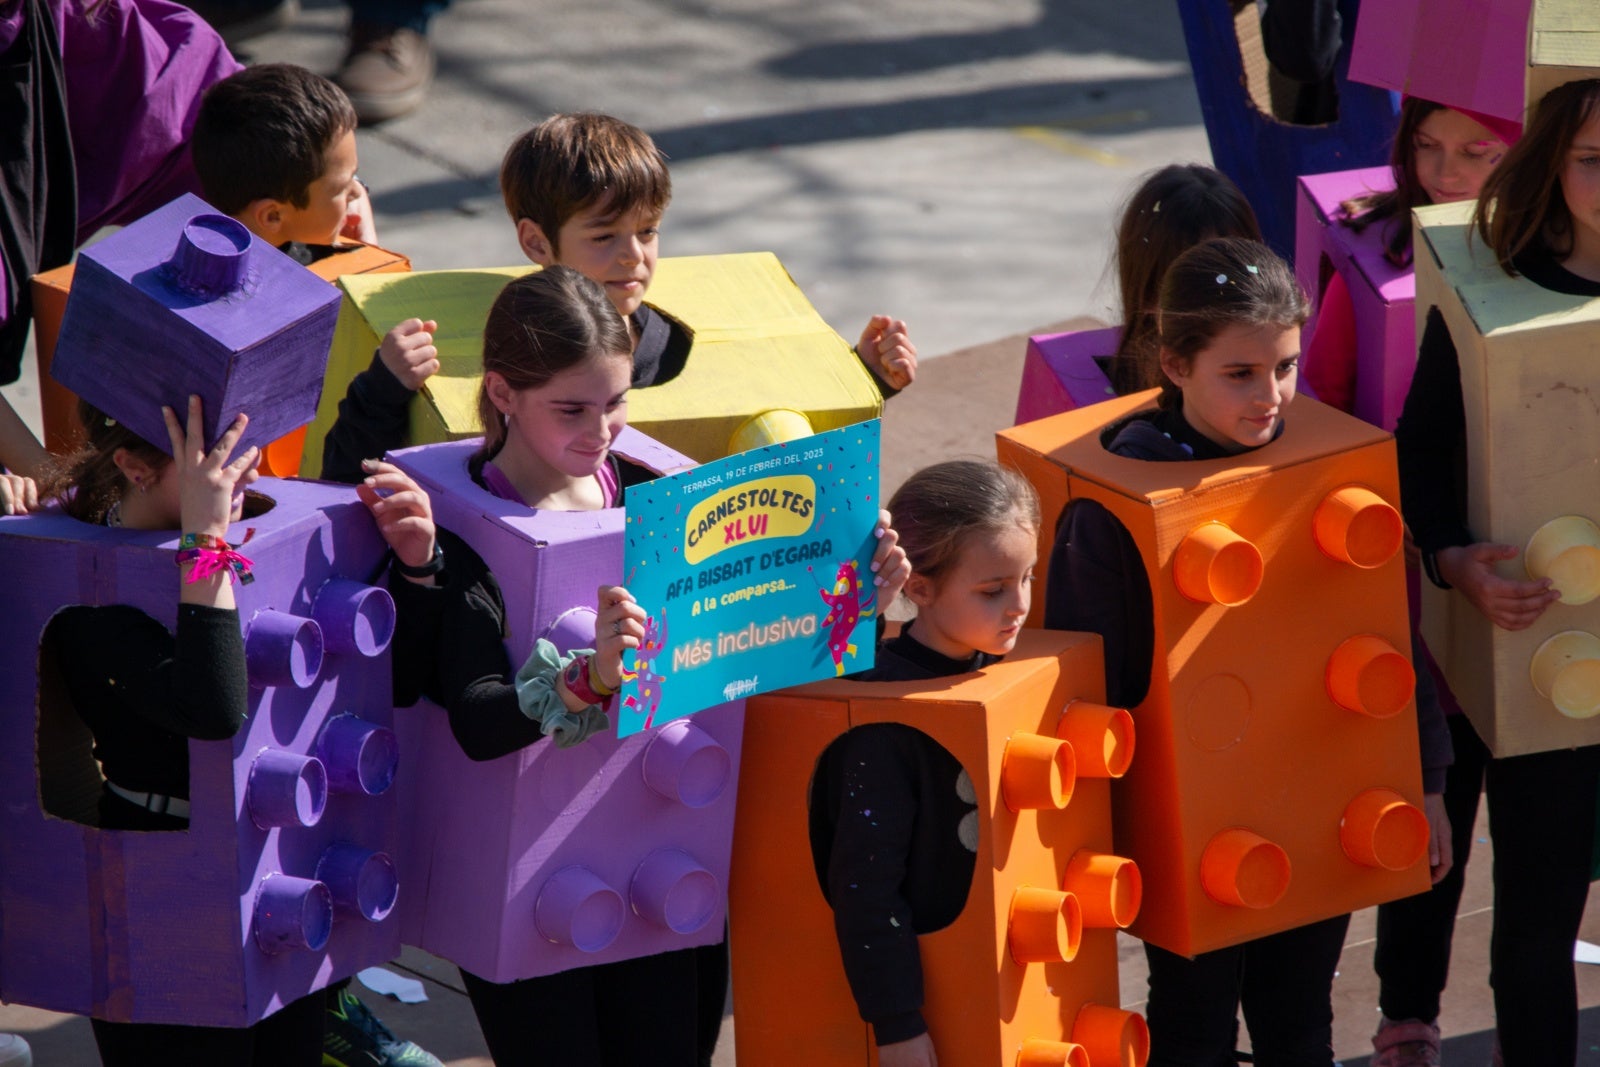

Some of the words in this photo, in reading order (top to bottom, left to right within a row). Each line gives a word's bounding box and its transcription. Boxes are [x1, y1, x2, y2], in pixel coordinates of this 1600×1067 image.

[683, 477, 723, 494] TERRASSA,
[726, 471, 734, 480] 19
[736, 466, 747, 478] DE
[749, 458, 782, 473] FEBRER
[784, 454, 801, 466] DEL
[803, 448, 824, 461] 2023
[688, 488, 813, 548] CARNESTOLTES
[666, 576, 693, 601] AFA
[698, 556, 755, 590] BISBAT
[760, 538, 833, 571] D'EGARA
[692, 600, 701, 616] A
[704, 597, 717, 612] la
[720, 579, 797, 606] comparsa...
[672, 639, 712, 673] Més
[717, 614, 817, 657] inclusiva
